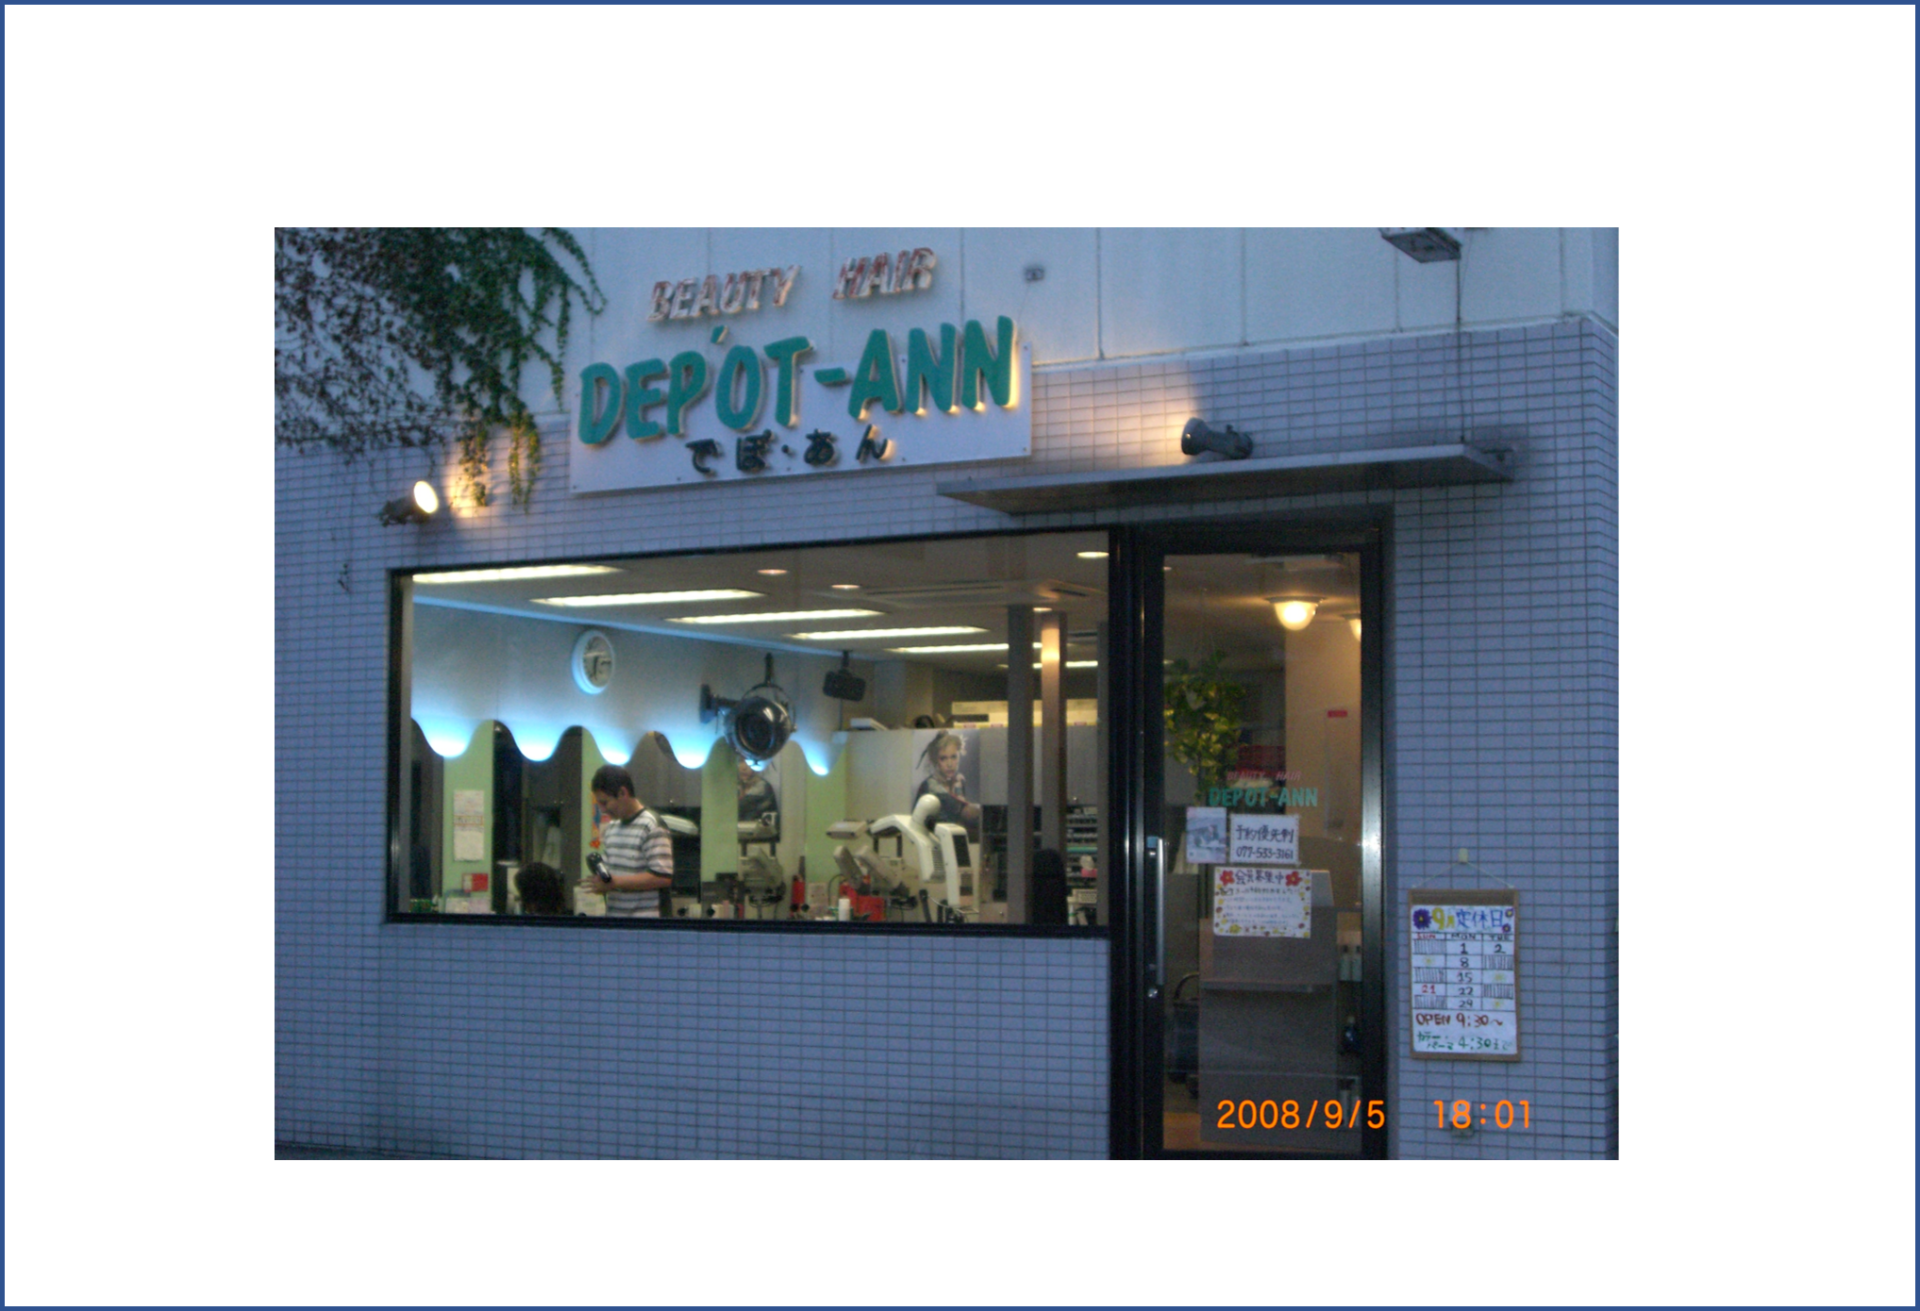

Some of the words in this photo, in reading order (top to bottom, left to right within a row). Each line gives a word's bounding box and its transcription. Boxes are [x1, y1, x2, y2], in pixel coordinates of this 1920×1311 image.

[648, 264, 799, 322] BEAUTY
[833, 247, 937, 300] HAIR
[1460, 943, 1469, 955] 1
[1494, 944, 1506, 955] 2
[1459, 957, 1469, 968] 8
[1457, 972, 1473, 983] 15
[1421, 984, 1436, 995] 21
[1458, 986, 1473, 996] 22
[1415, 1012, 1451, 1026] OPEN
